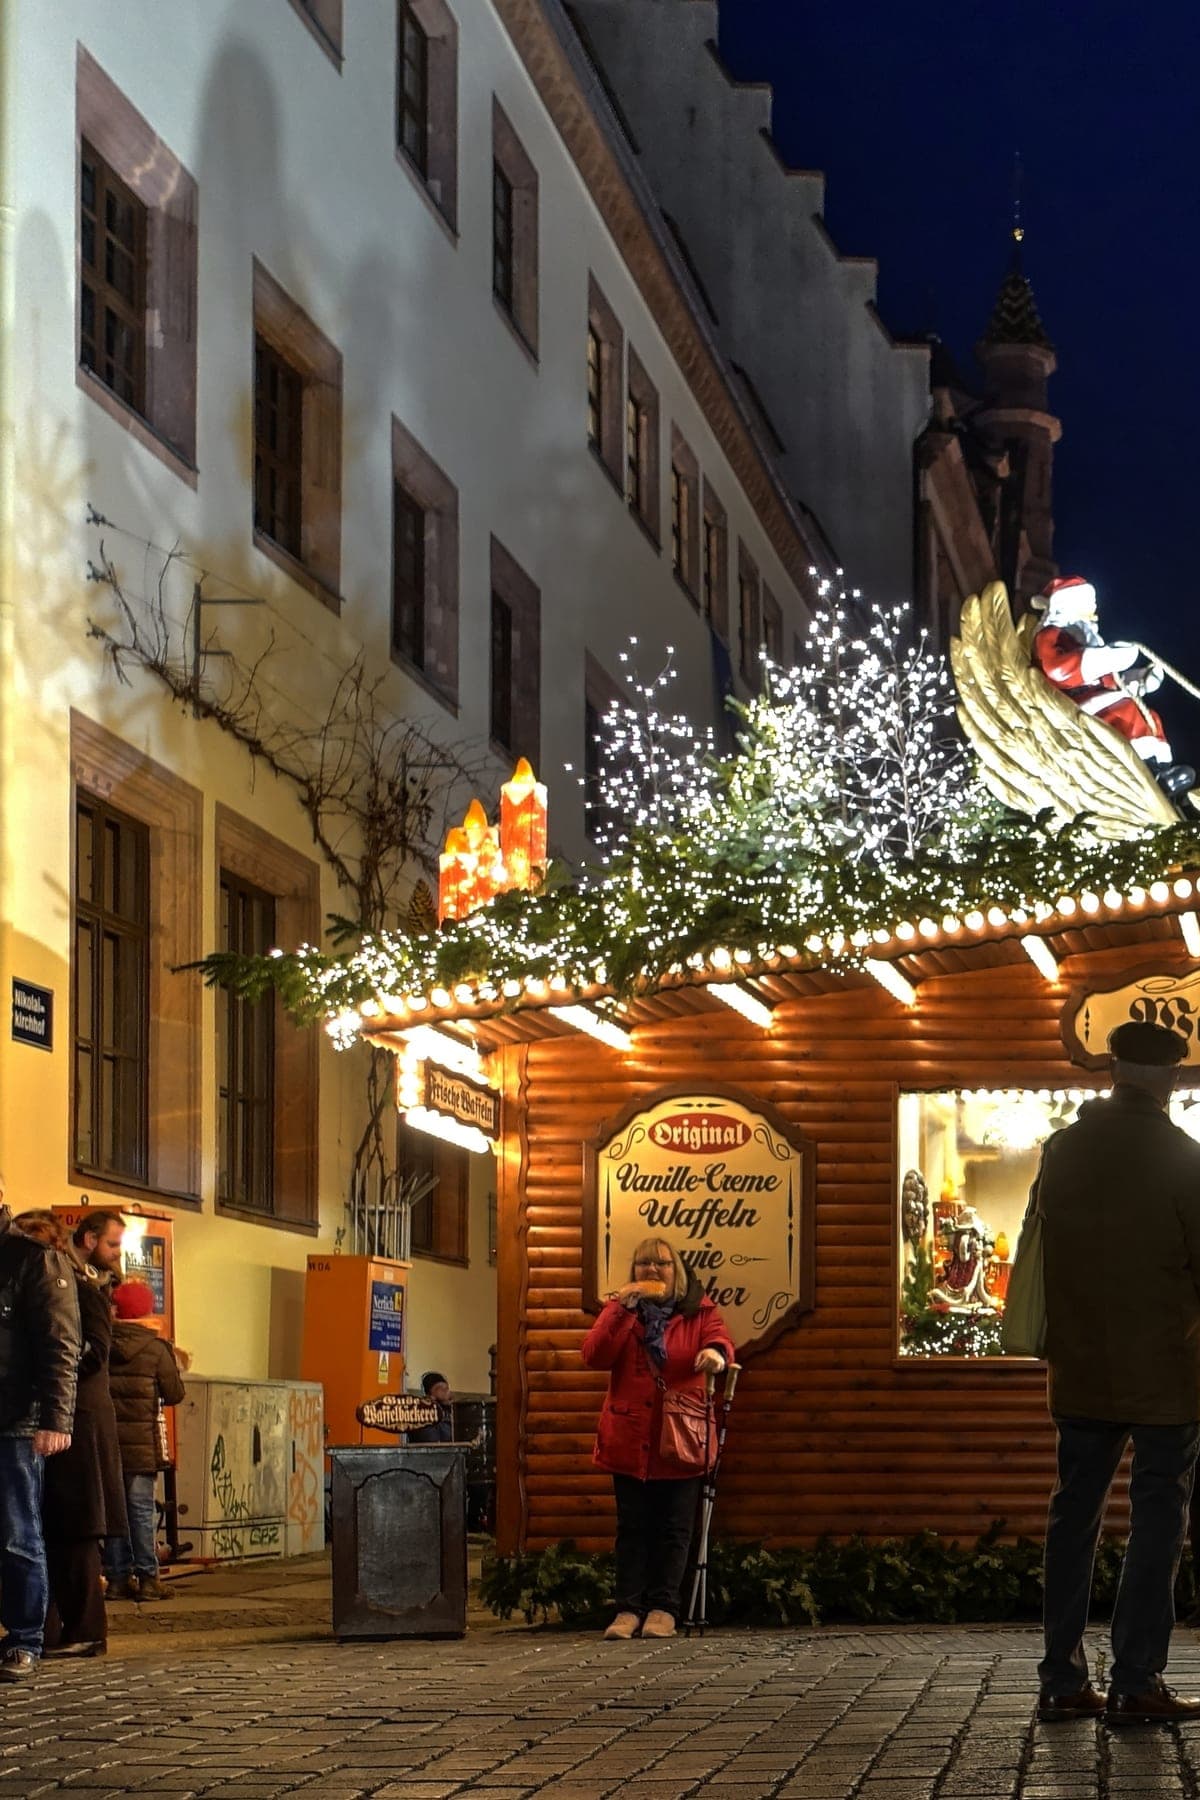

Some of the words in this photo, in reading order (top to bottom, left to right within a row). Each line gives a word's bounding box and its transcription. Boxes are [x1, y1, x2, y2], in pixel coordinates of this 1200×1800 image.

[14, 1008, 46, 1036] kirchhof
[654, 1118, 745, 1150] Original
[616, 1162, 783, 1193] Vanille-Creme
[639, 1198, 761, 1240] Waffeln
[363, 1403, 440, 1426] Waffelbäckerei
